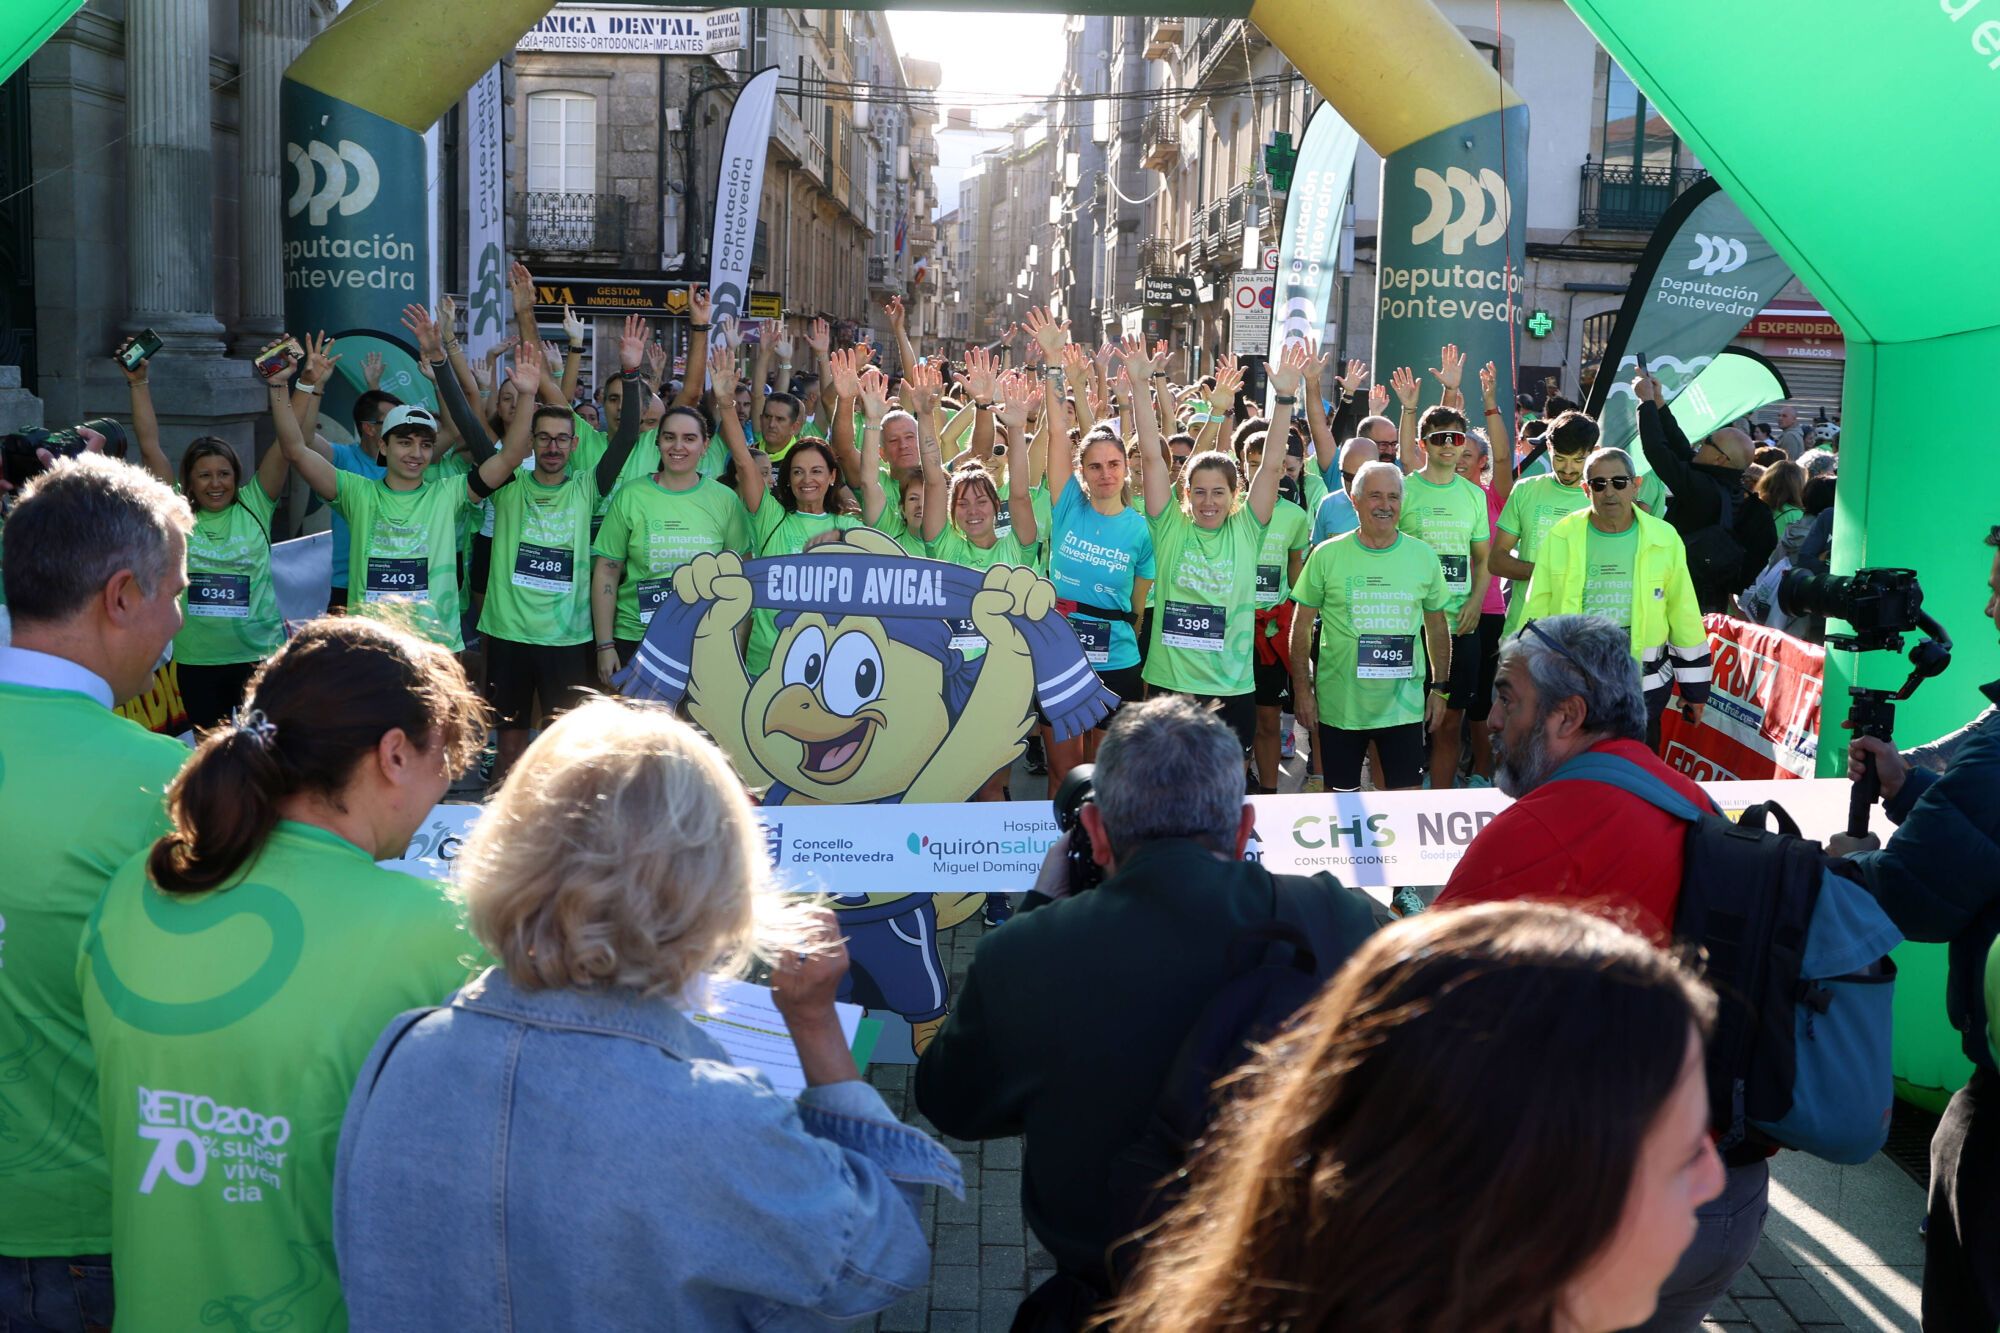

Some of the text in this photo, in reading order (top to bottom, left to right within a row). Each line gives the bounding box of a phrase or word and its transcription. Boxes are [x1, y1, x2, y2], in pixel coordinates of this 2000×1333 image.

[530, 15, 700, 36] INICA DENTAL
[706, 12, 740, 27] CLINICA
[706, 27, 741, 41] DENTAL
[720, 157, 741, 271] Deputación
[731, 158, 754, 273] Pontevedra
[1288, 171, 1319, 286] Deputación
[1303, 171, 1336, 288] Pontevedra
[597, 286, 640, 296] GESTION
[1147, 280, 1173, 291] Viajes
[1660, 276, 1760, 303] Deputación
[587, 296, 654, 308] INMOBILIARIA
[1146, 290, 1173, 300] Deza
[1657, 290, 1756, 318] Pontevedra
[1786, 347, 1832, 357] TABACOS
[651, 533, 665, 544] En
[1064, 530, 1077, 546] En
[1078, 539, 1131, 564] marcha
[529, 559, 562, 573] 2488
[381, 573, 415, 585] 2403
[767, 564, 947, 606] EQUIPO AVIGAL
[1586, 579, 1602, 590] En
[201, 588, 235, 600] 0343
[652, 588, 673, 603] 08
[1352, 589, 1414, 601] En marcha
[1352, 601, 1412, 615] contra o
[1177, 617, 1210, 631] 1398
[1352, 617, 1411, 630] cancro
[1080, 634, 1095, 646] 23
[1373, 649, 1403, 661] 0495
[1291, 813, 1397, 850] CHS
[792, 838, 854, 850] Concello
[792, 851, 894, 863] de Pontevedra
[1294, 855, 1398, 867] CONSTRUCCIONES
[1420, 849, 1445, 860] Good
[933, 861, 979, 875] Miguel
[222, 1140, 288, 1169] super
[223, 1158, 281, 1190] viven
[222, 1181, 263, 1203] cia
